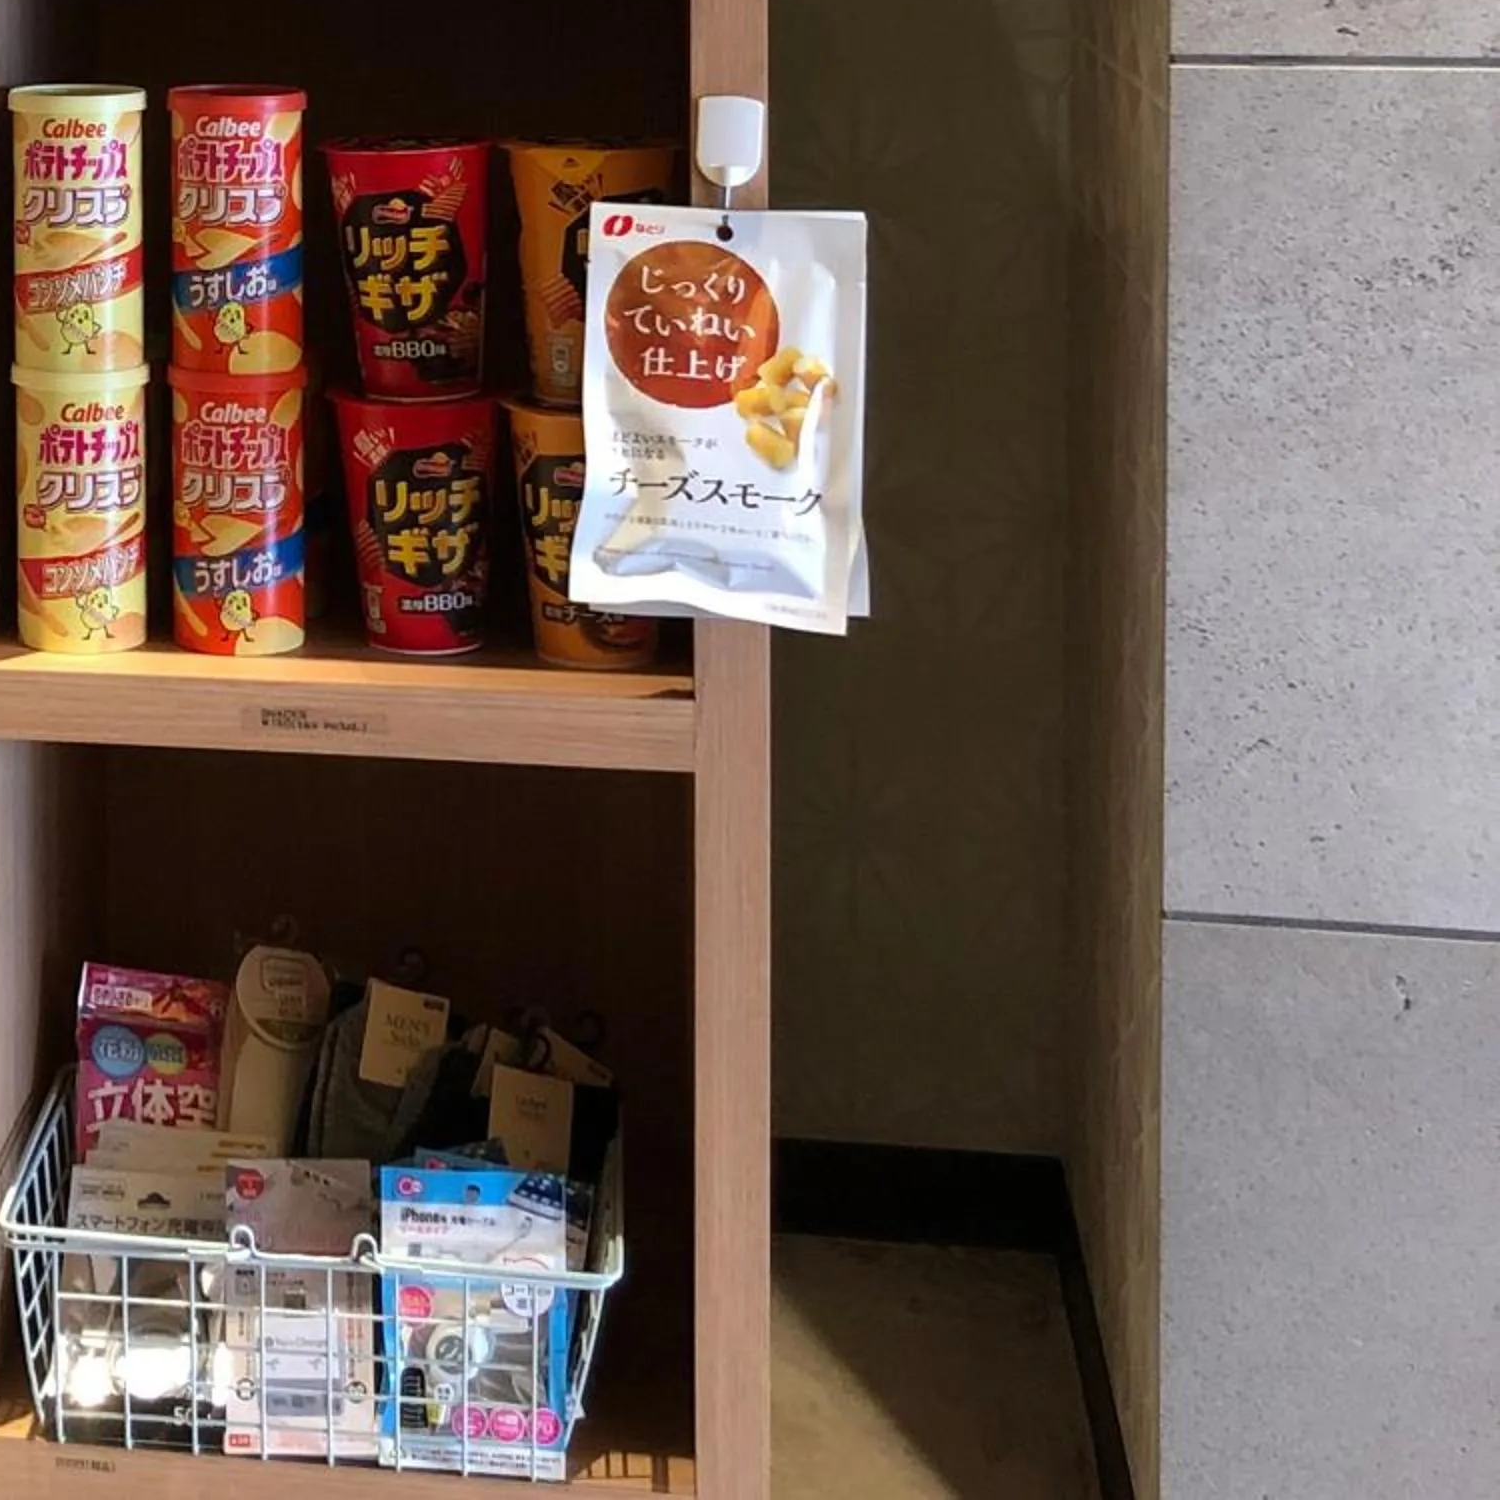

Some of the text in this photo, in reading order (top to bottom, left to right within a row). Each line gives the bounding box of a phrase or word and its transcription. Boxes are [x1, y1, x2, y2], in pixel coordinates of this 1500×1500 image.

[42, 118, 107, 139] Calbee
[196, 116, 261, 138] Calbee
[24, 139, 128, 181] ポテトチップス
[179, 136, 285, 182] ポテトチップス
[24, 185, 132, 228] クリスプ
[179, 185, 286, 228] クリスプ
[635, 221, 666, 235] なとり
[345, 224, 450, 271] リッチ
[357, 272, 449, 322] ギザ
[640, 266, 746, 299] じっくり
[624, 307, 757, 338] ていねい
[640, 347, 747, 384] 仕上げ
[61, 403, 125, 423] Calbee
[201, 402, 267, 423] Calbee
[40, 420, 140, 465] ポテトチップス
[182, 420, 290, 469] ポテトチップス
[37, 466, 143, 514] クリスプ
[182, 467, 292, 513] クリスプ
[375, 480, 481, 524] リッチ
[609, 467, 823, 517] チーズスモーク
[387, 522, 479, 577] ギザ
